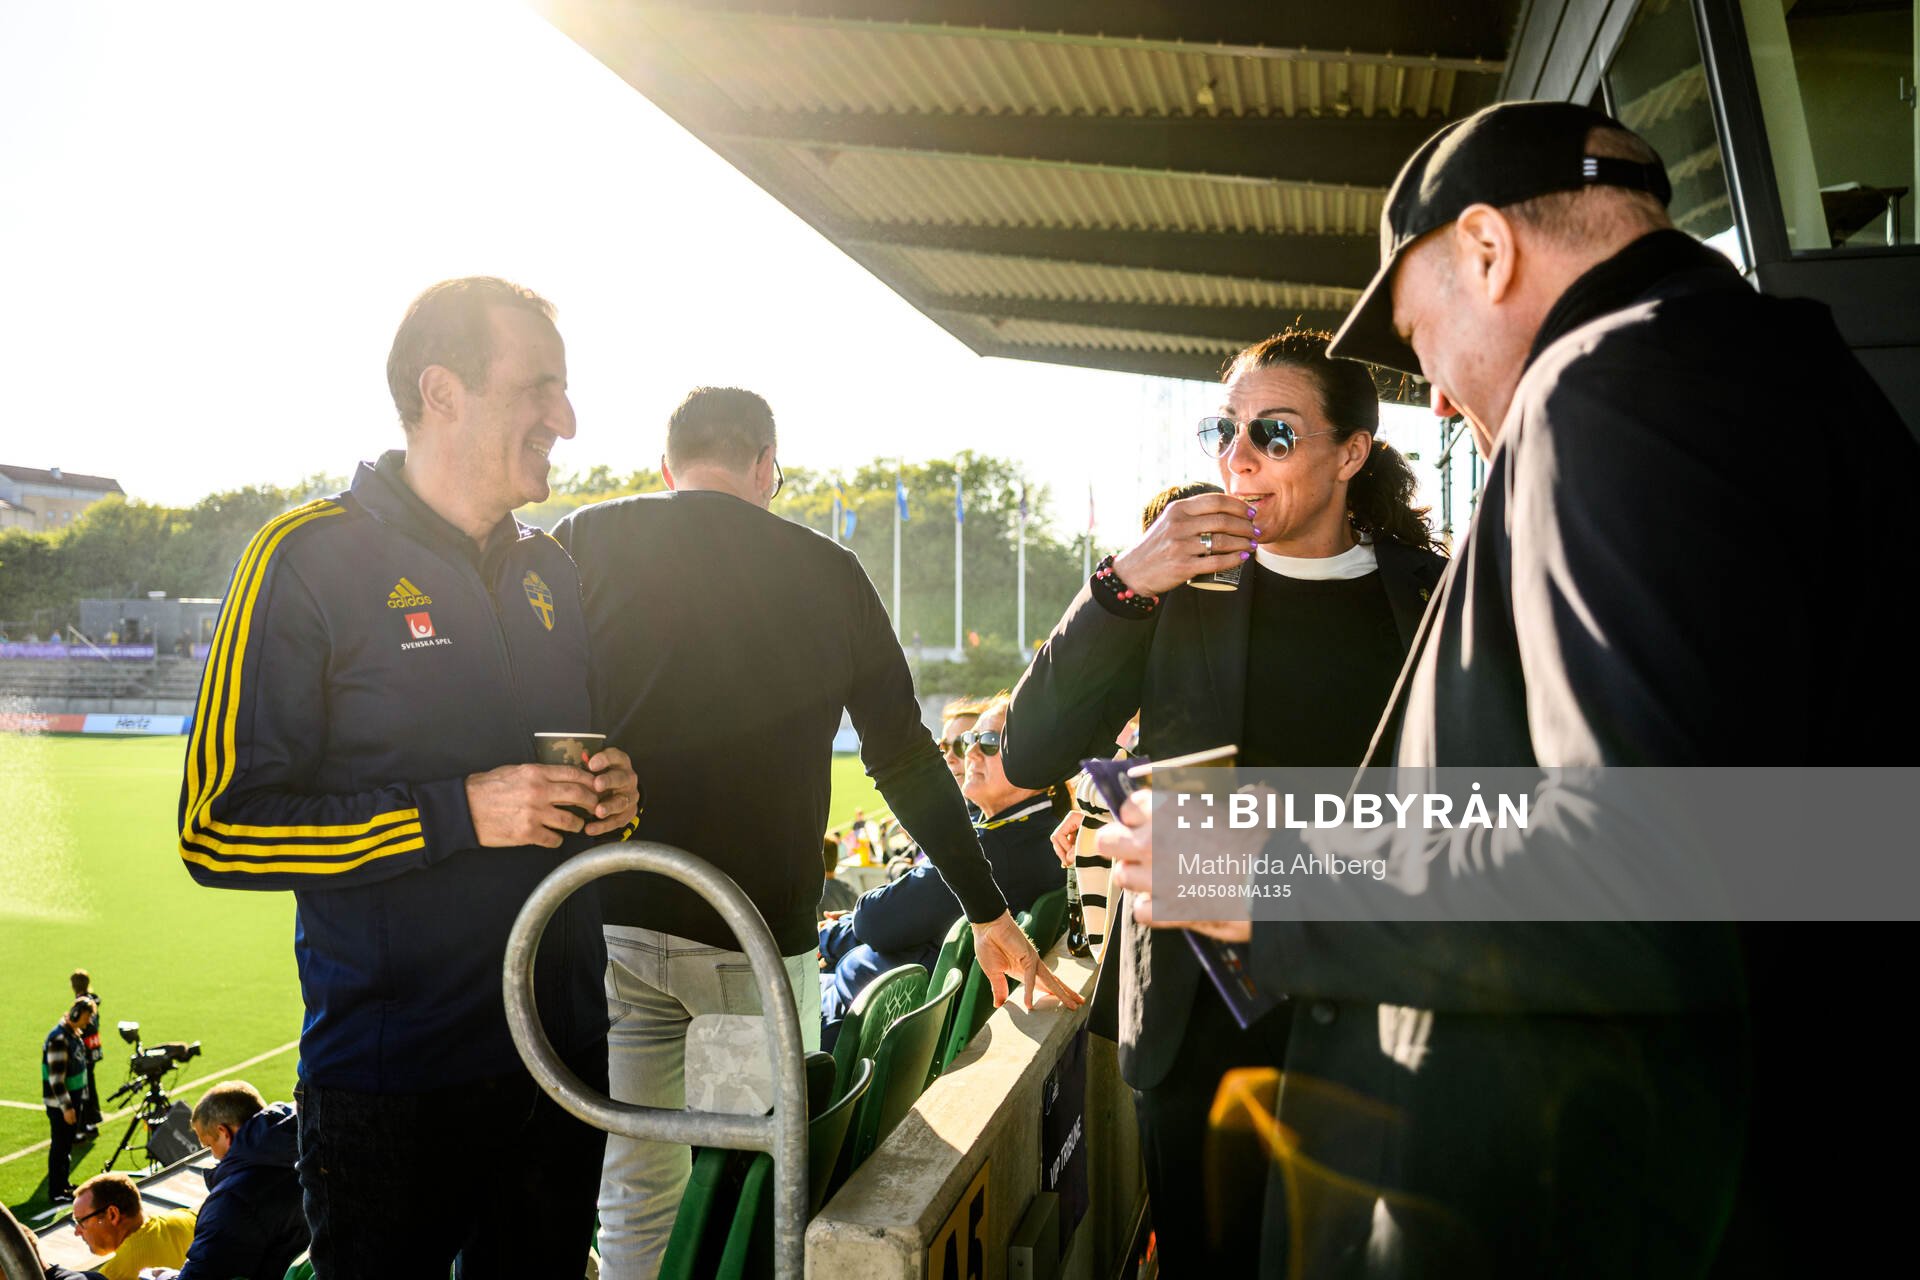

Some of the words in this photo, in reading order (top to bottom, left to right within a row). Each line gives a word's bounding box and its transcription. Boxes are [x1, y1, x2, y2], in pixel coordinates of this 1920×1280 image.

[387, 594, 432, 608] adidas
[401, 640, 434, 650] SVENSKA
[435, 637, 453, 646] SPEL
[115, 716, 151, 729] Hertz
[1050, 1155, 1060, 1190] VIP
